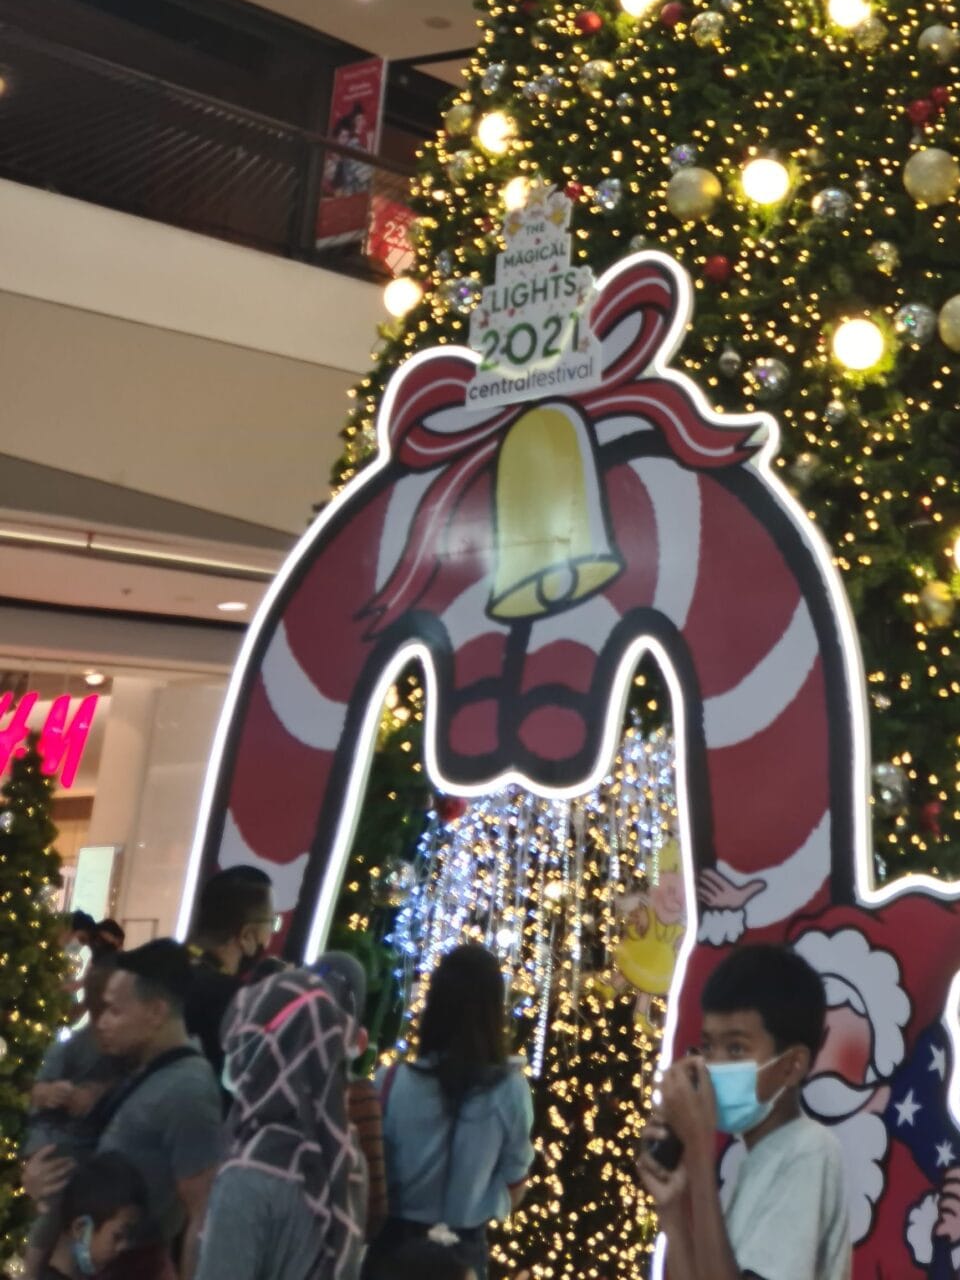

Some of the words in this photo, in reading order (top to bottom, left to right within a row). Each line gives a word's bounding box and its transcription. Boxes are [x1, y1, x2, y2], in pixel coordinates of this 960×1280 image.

[525, 222, 545, 236] THE
[503, 243, 567, 269] MAGICAL
[491, 271, 577, 313] LIGHTS
[480, 310, 580, 371] 2021
[468, 357, 594, 401] centralfestival
